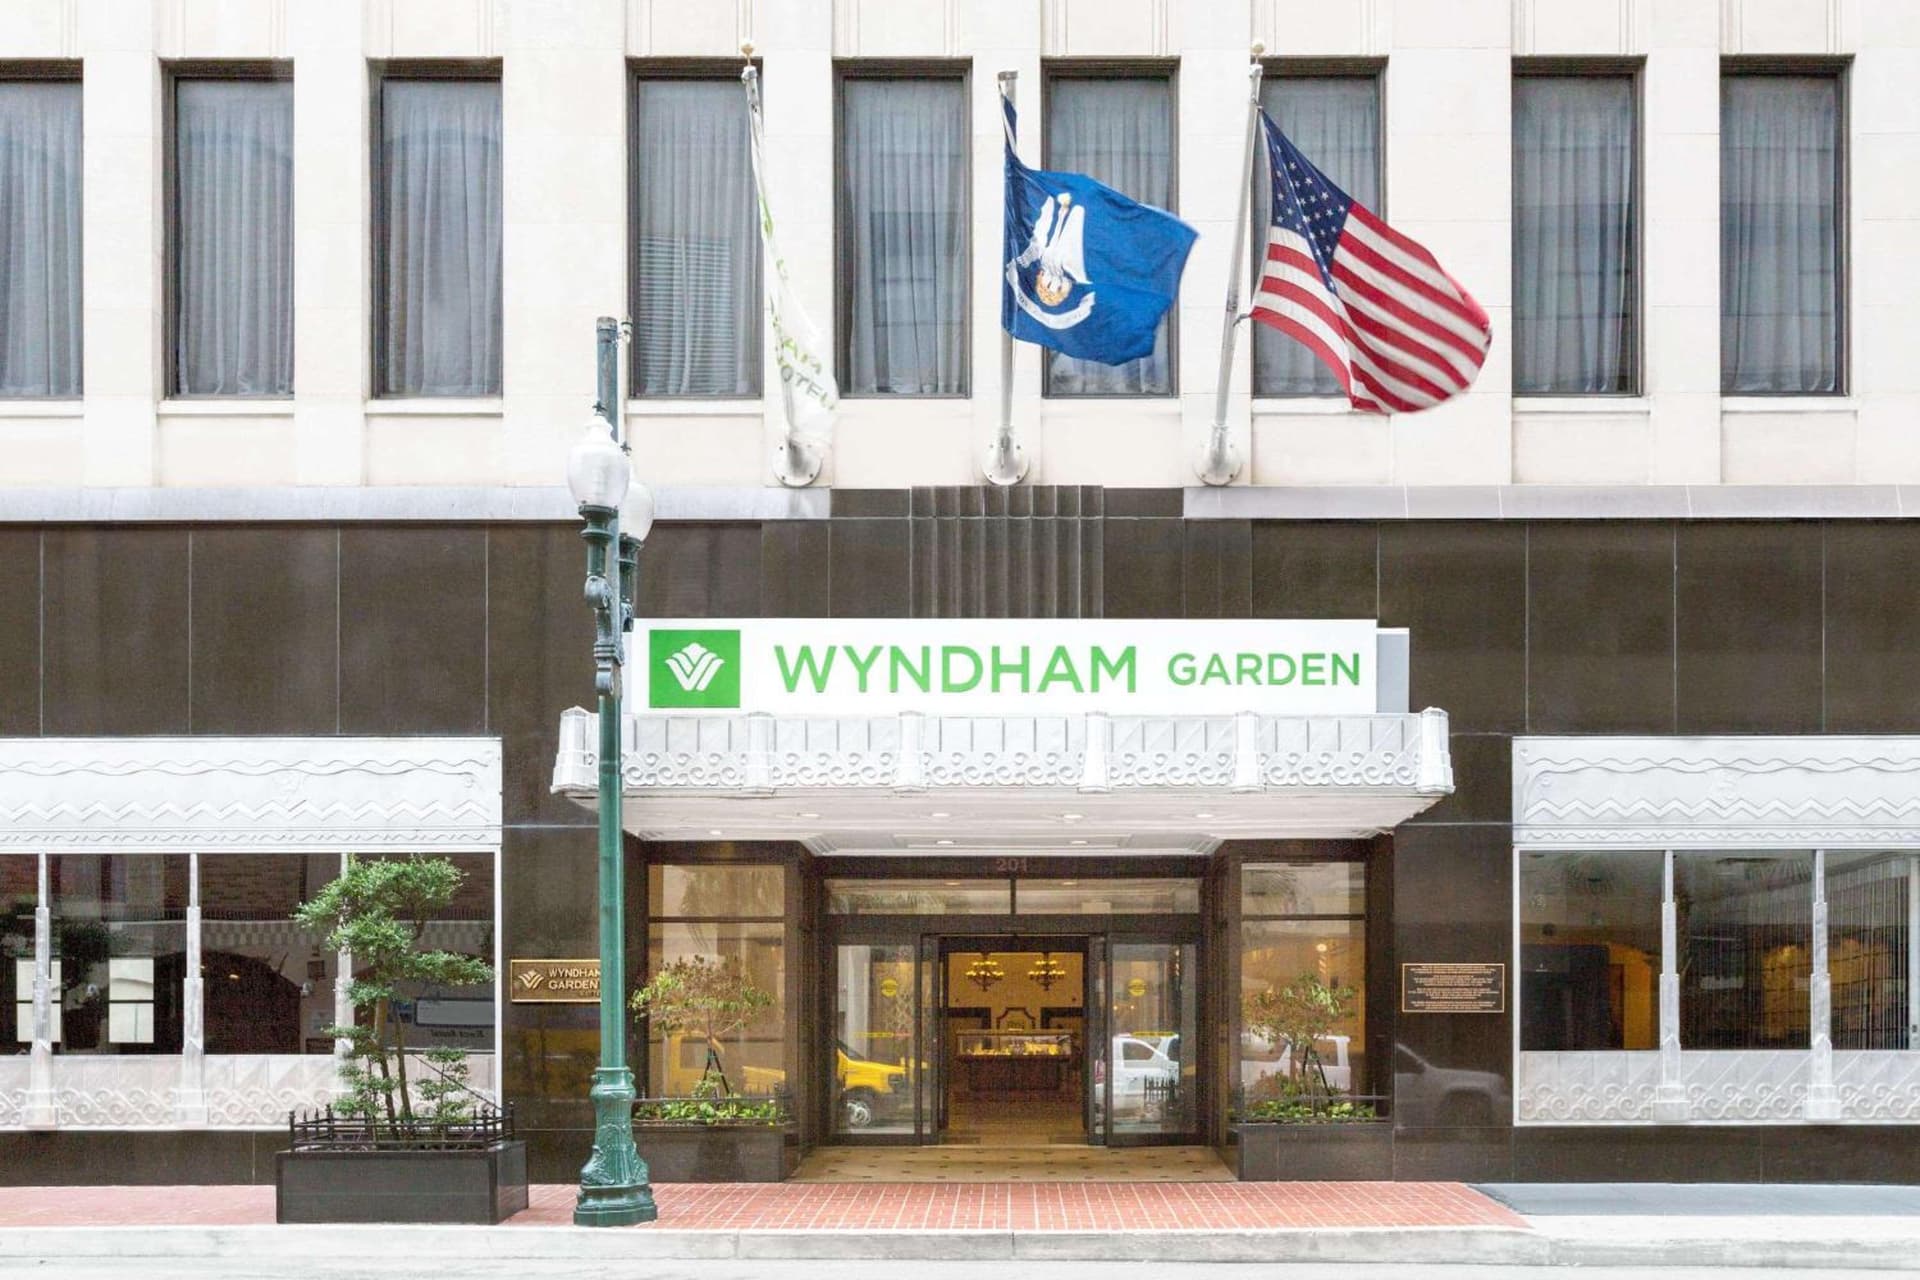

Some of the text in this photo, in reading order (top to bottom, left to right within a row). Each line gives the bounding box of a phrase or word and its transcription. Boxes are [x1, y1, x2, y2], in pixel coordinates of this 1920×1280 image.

[775, 645, 1360, 693] WYNDHAM GARDEN
[548, 979, 599, 990] GARDEN
